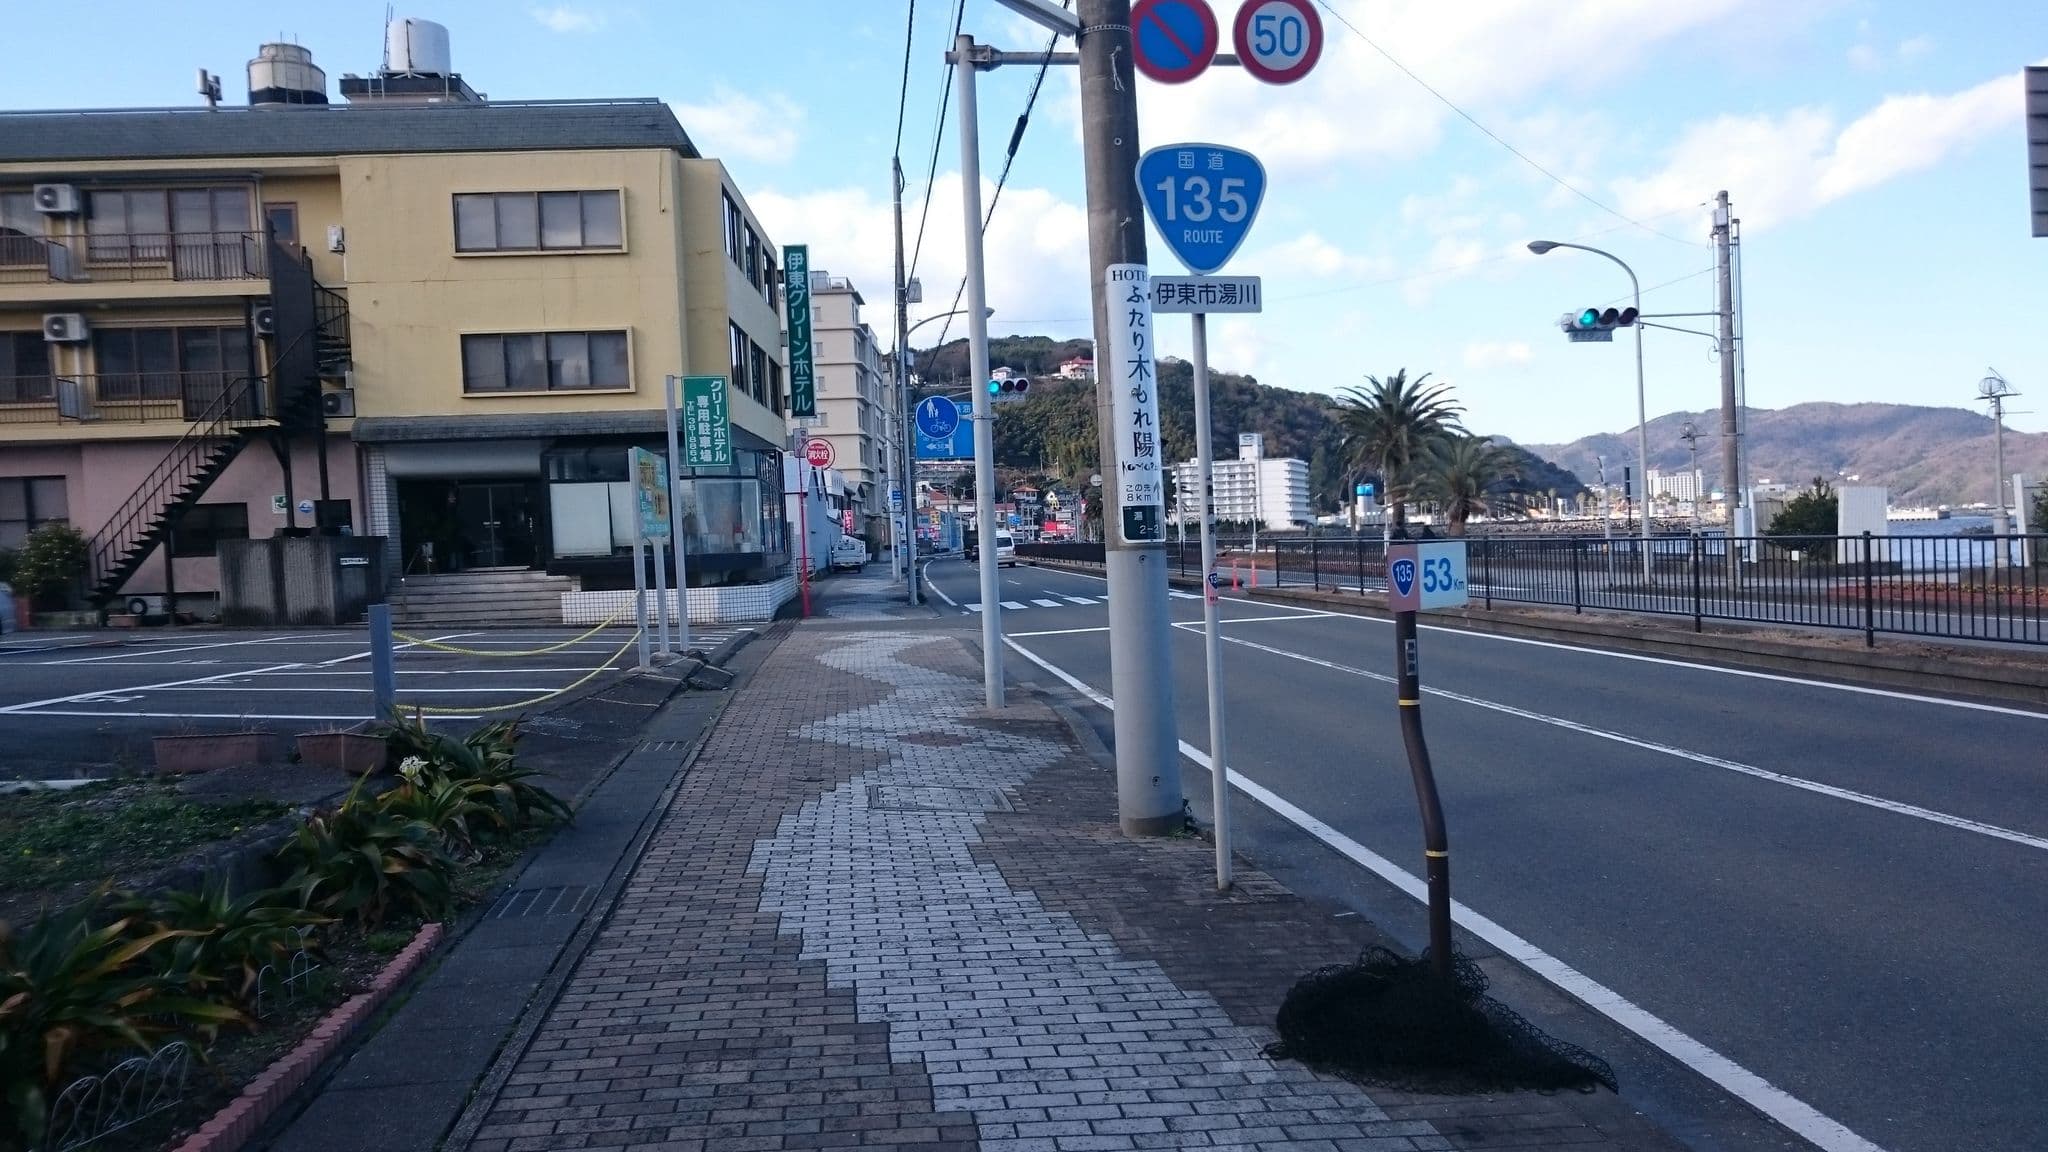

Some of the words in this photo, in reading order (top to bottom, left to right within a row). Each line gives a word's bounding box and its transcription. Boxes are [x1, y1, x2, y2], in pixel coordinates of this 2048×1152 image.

[1255, 15, 1302, 57] 50
[1178, 152, 1224, 170] 国道
[1157, 176, 1248, 223] 135
[1184, 230, 1224, 243] ROUTE
[1156, 283, 1256, 305] 伊東市湯川
[787, 252, 811, 412] 伊東グリーンホテル
[696, 395, 713, 462] 専用駐車場
[710, 380, 727, 462] グリーンホテル
[1395, 565, 1412, 582] 135
[1424, 558, 1452, 592] 53
